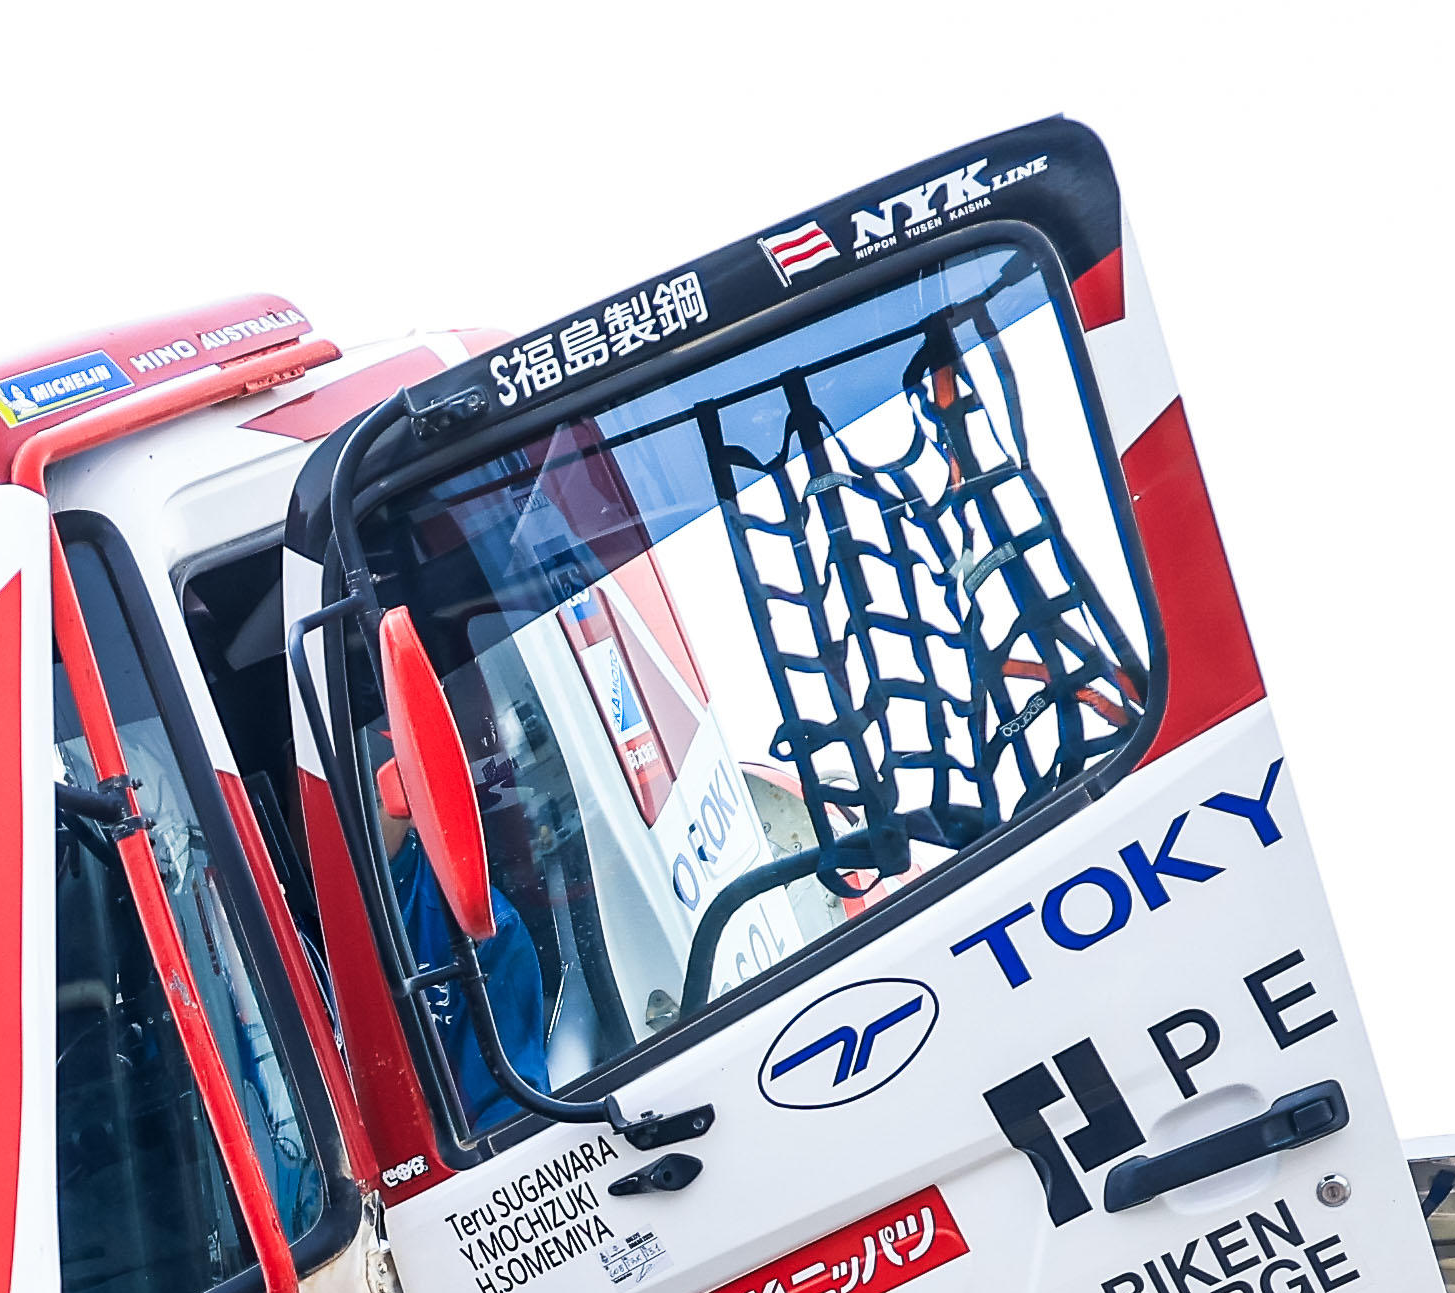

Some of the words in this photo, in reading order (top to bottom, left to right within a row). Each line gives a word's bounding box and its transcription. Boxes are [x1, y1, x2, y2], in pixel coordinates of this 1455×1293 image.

[851, 159, 989, 249] NYK
[991, 155, 1049, 189] LINE
[855, 235, 898, 260] NIPPON
[905, 216, 943, 239] YUSEN
[949, 197, 992, 221] KAISHA
[30, 362, 112, 404] MICHELIN
[130, 340, 199, 373] HINO
[200, 308, 305, 350] AUSTRALIA
[950, 756, 1286, 990] TOKY
[446, 1201, 495, 1242] Teru
[493, 1136, 619, 1218] SUGAWARA
[459, 1182, 600, 1271] Y.MOCHIZUKI
